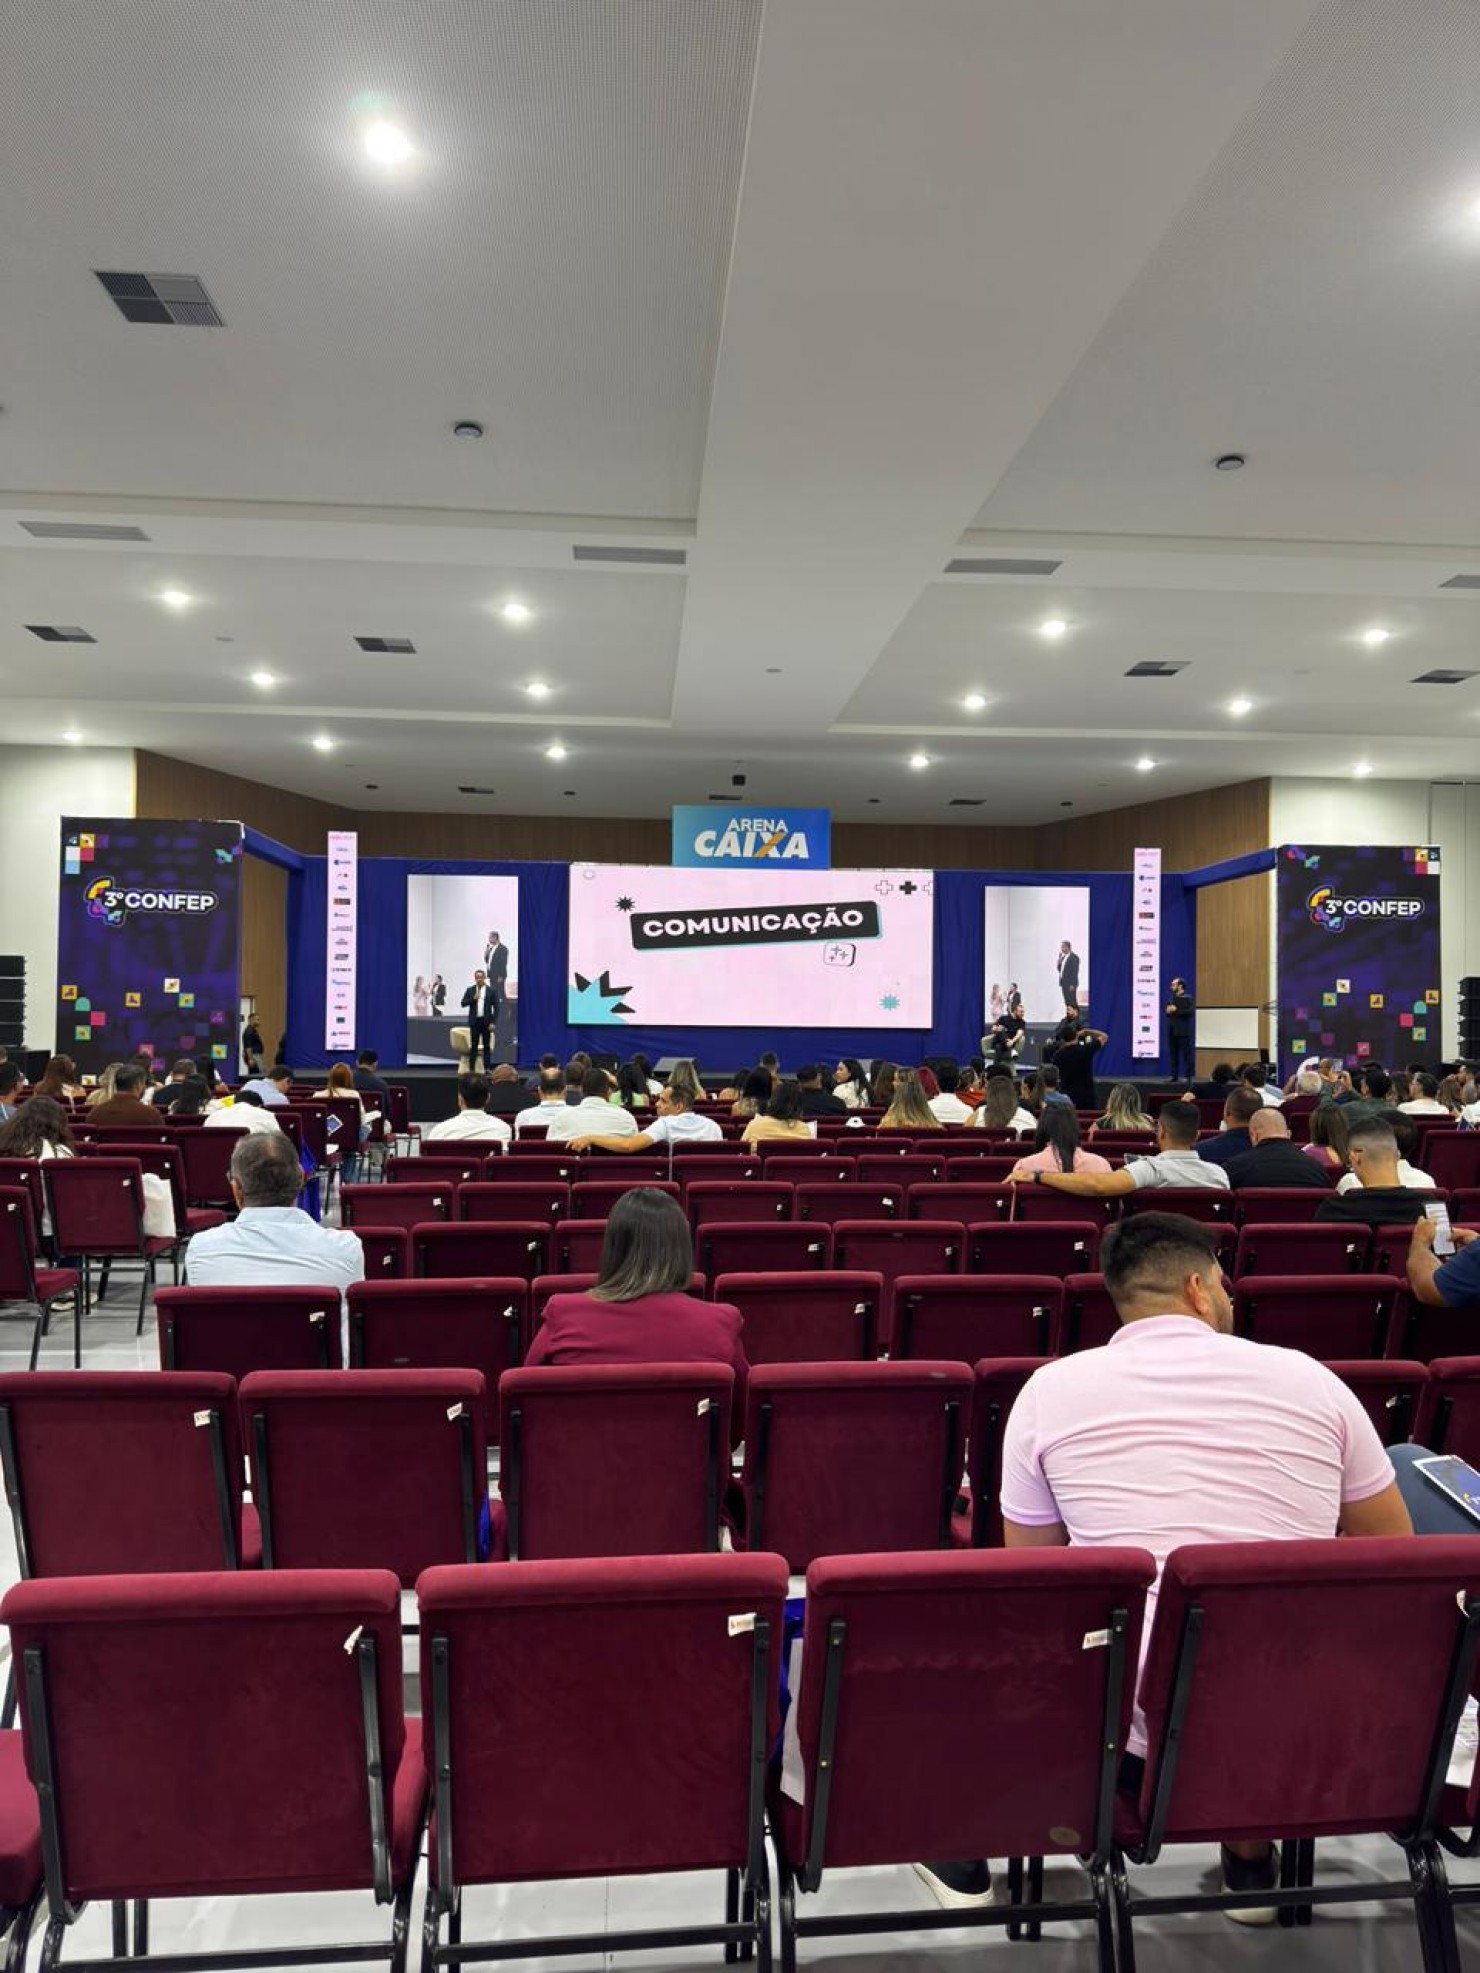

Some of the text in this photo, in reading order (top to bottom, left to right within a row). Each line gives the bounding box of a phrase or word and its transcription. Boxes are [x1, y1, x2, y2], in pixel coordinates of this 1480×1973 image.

[727, 818, 788, 832] ARENA
[694, 830, 810, 858] CAIXA
[642, 907, 864, 938] COMUNICAÇÃO
